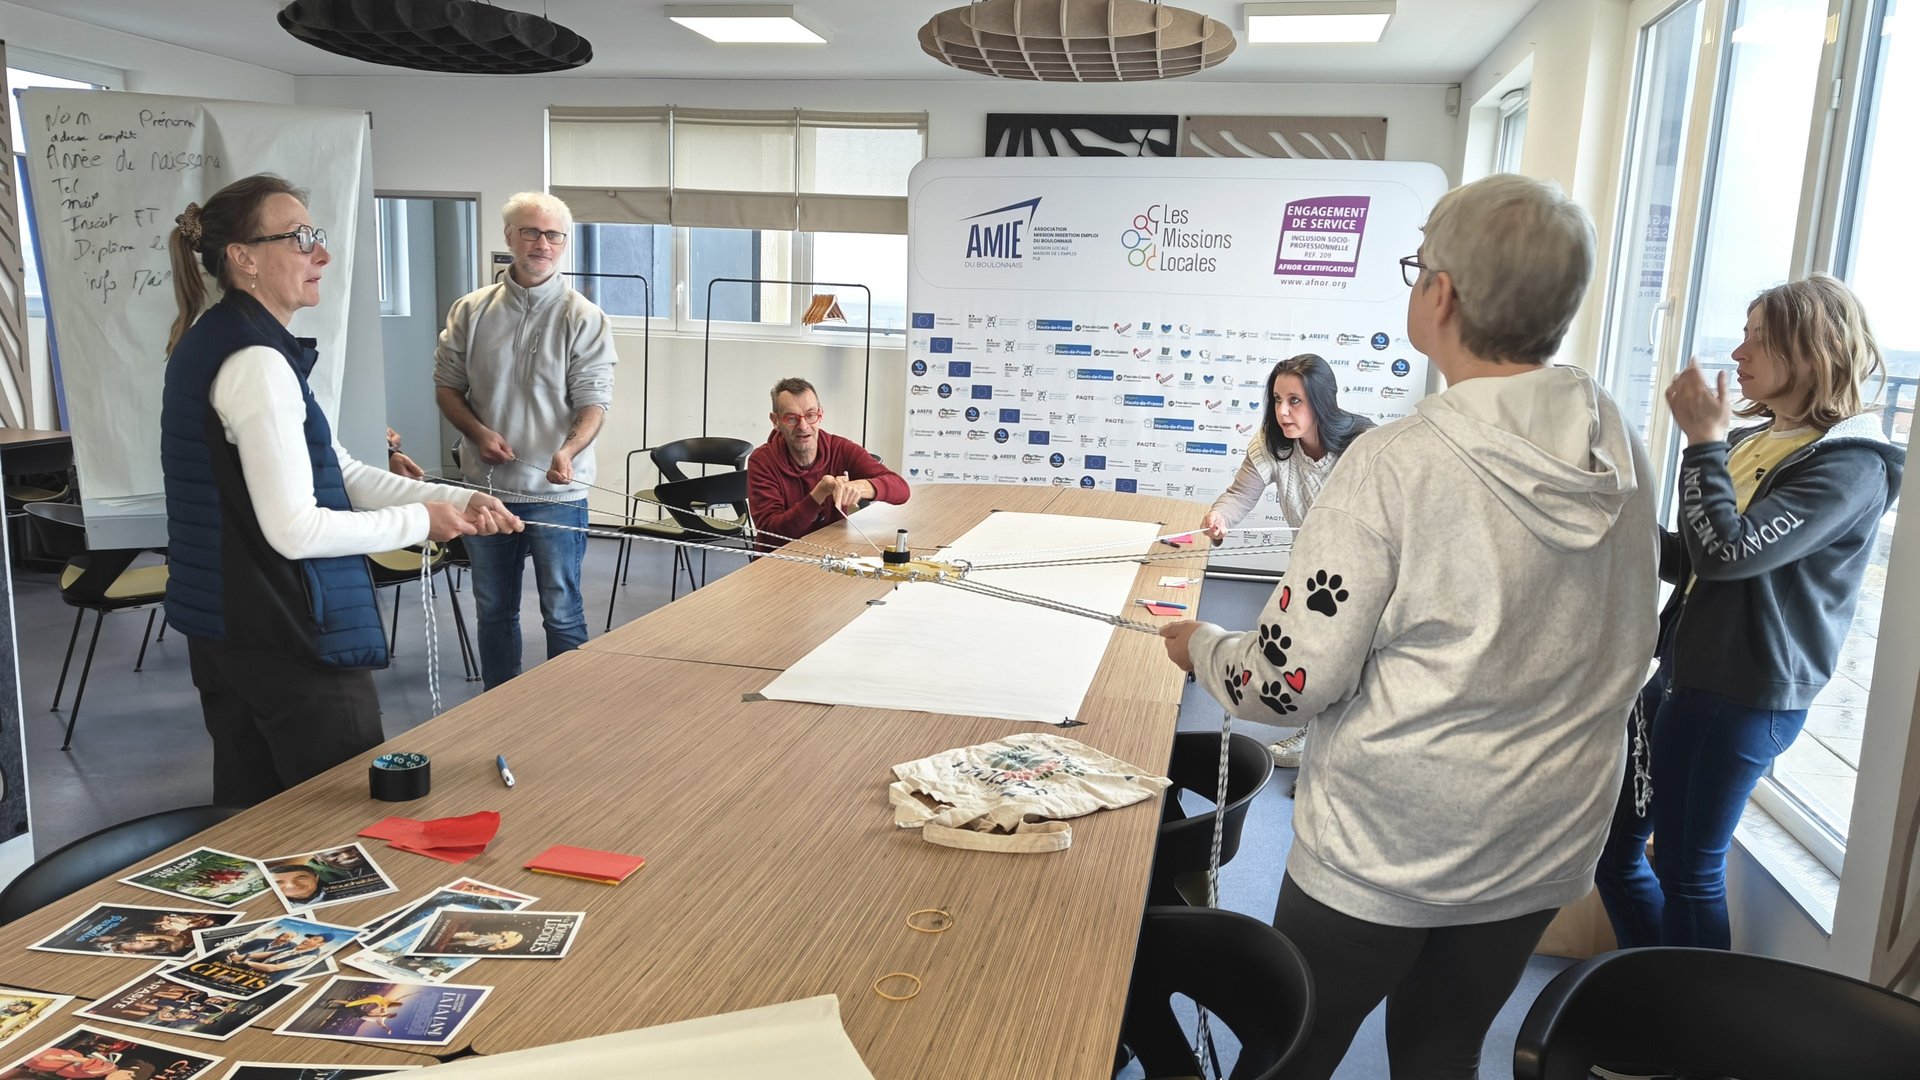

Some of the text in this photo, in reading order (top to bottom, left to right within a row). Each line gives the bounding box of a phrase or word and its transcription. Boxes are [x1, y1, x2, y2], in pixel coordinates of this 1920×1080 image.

[1164, 204, 1189, 224] Les
[1287, 205, 1366, 218] ENGAGEMENT
[1292, 218, 1357, 230] DE SERVICE
[966, 220, 1023, 259] AMIE
[1162, 228, 1232, 249] Missions
[1290, 242, 1348, 251] PROFESSIONNELLE
[976, 261, 1023, 269] BOULONNAIS
[1160, 251, 1217, 273] Locales
[1278, 263, 1354, 273] AFNOR CERTIFICATION
[1280, 278, 1347, 289] www.afnor.org
[1186, 447, 1227, 455] Hauts-de-France
[1684, 466, 1702, 502] DAY
[1685, 503, 1719, 548] NEW
[1741, 510, 1805, 559] TODAY
